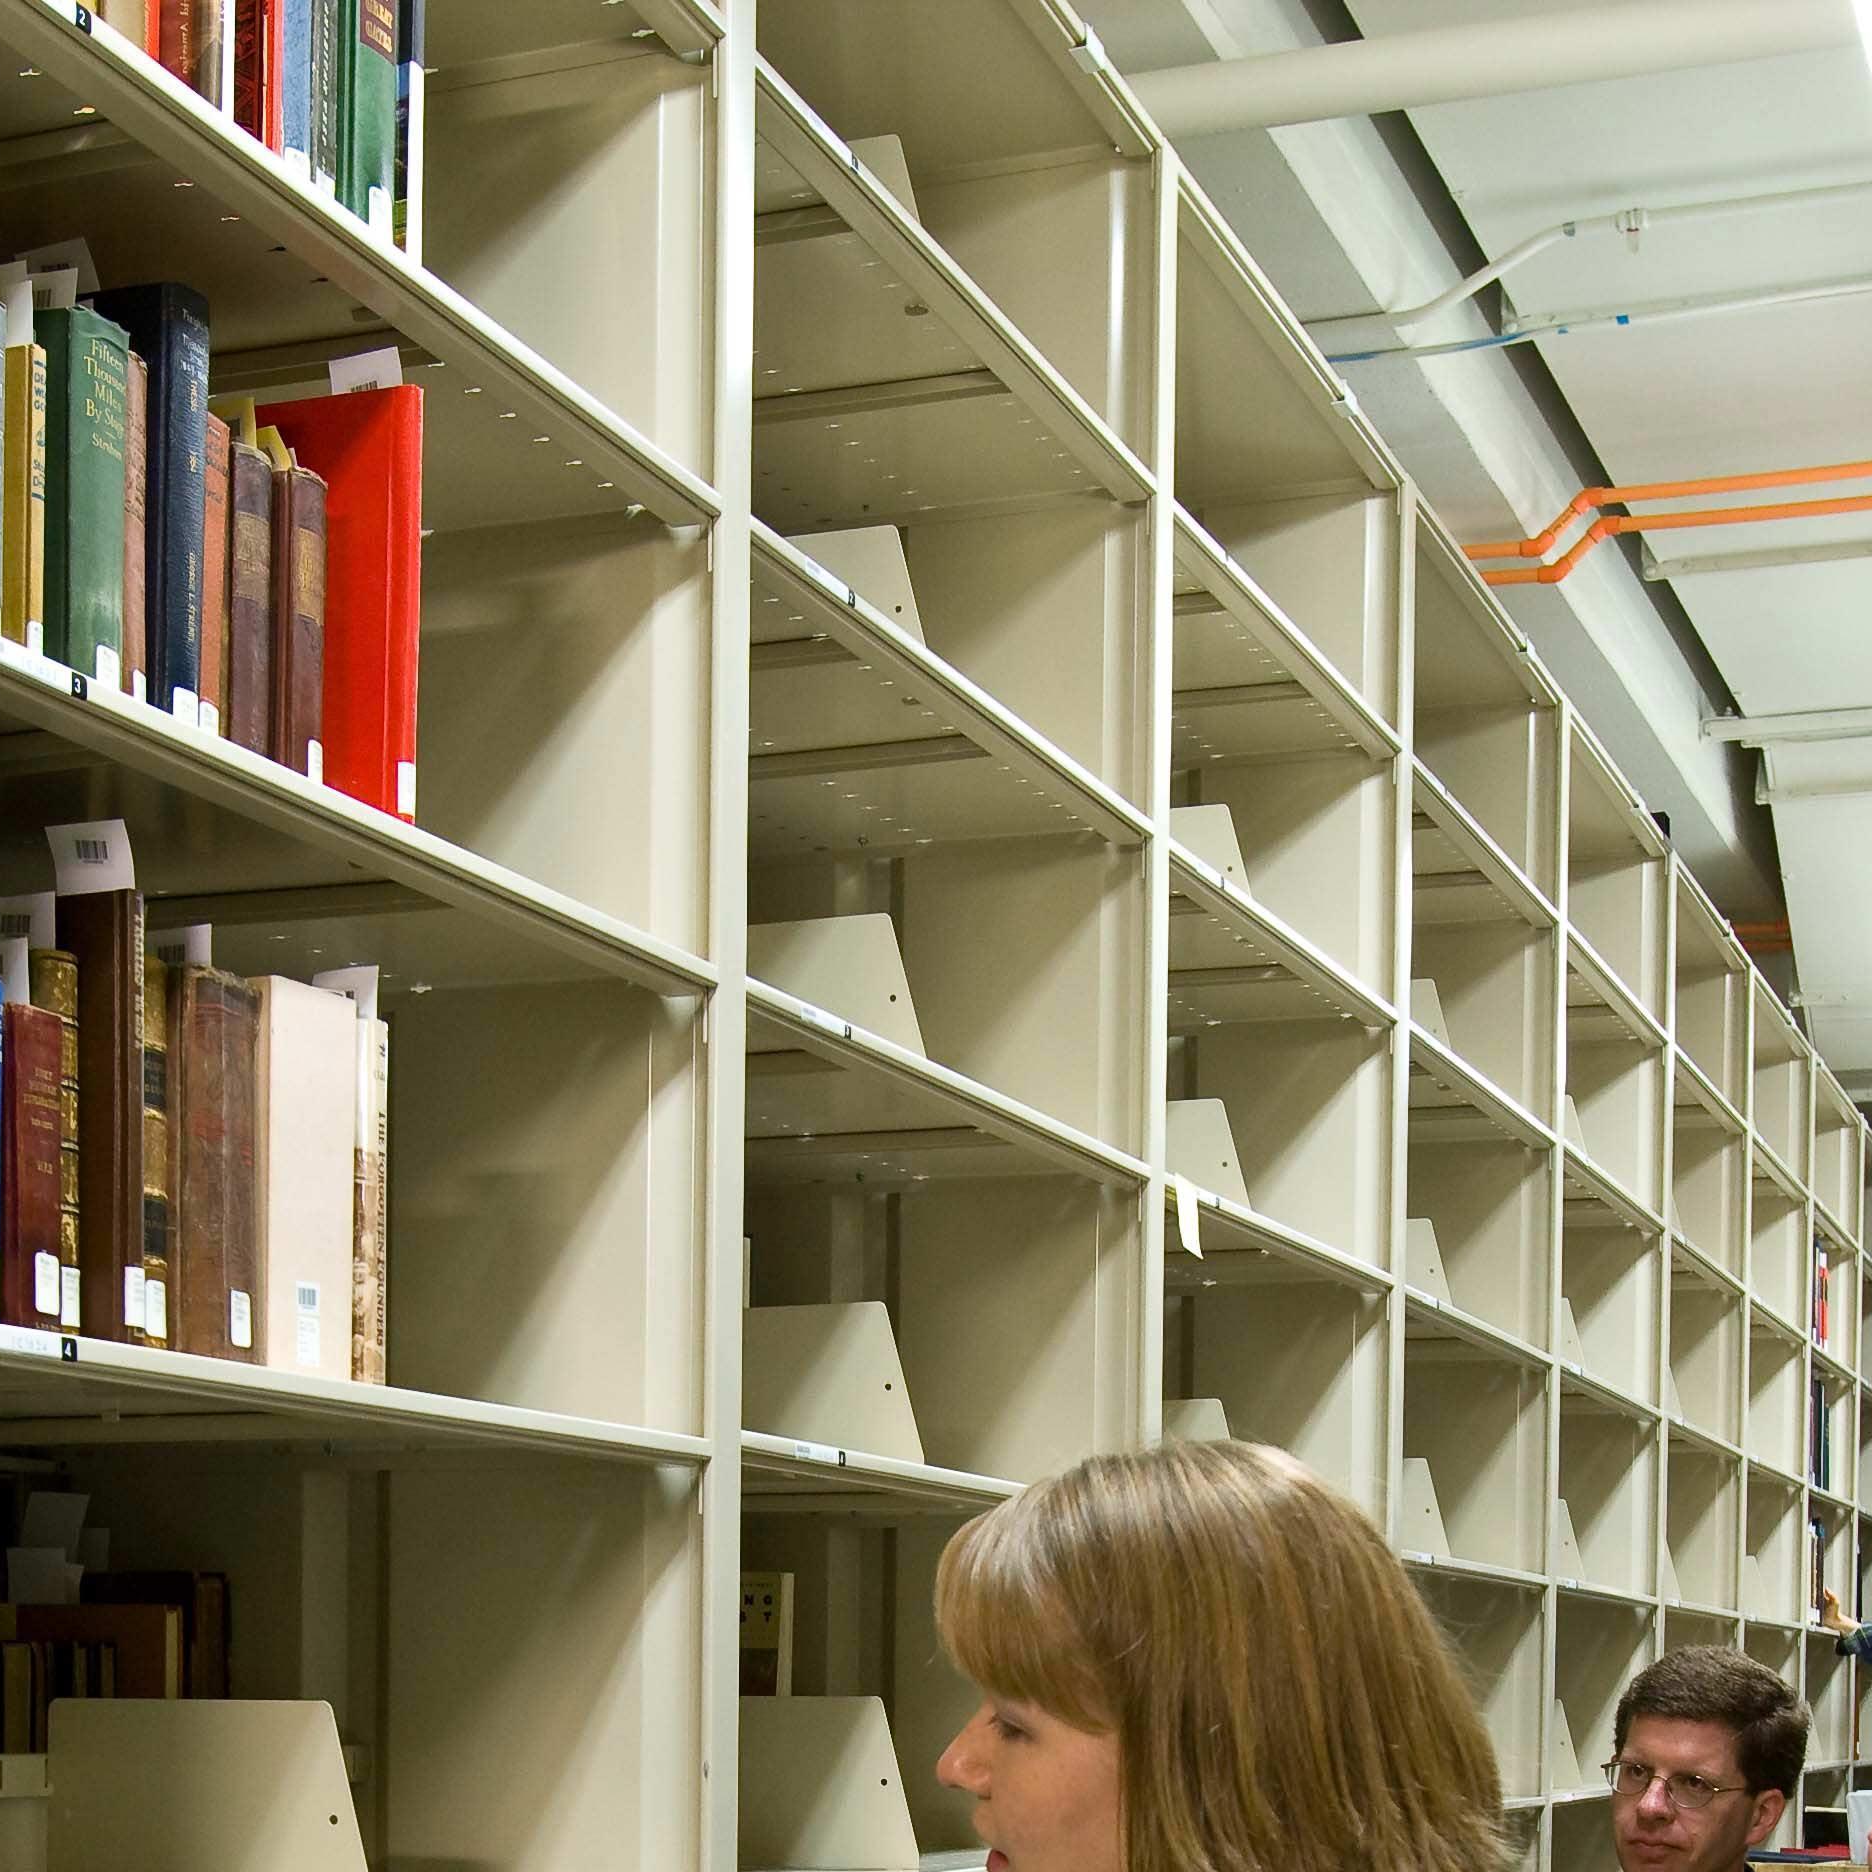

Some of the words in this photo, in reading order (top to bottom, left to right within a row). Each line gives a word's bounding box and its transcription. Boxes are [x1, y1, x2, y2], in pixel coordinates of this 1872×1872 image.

[78, 9, 86, 26] 2
[91, 338, 124, 374] Fifteen
[86, 399, 102, 424] By
[95, 381, 123, 413] Miles
[73, 677, 81, 694] 3
[376, 1111, 386, 1145] THE
[376, 1151, 387, 1253] FORGOTTEN
[375, 1257, 386, 1347] FOUNDERS
